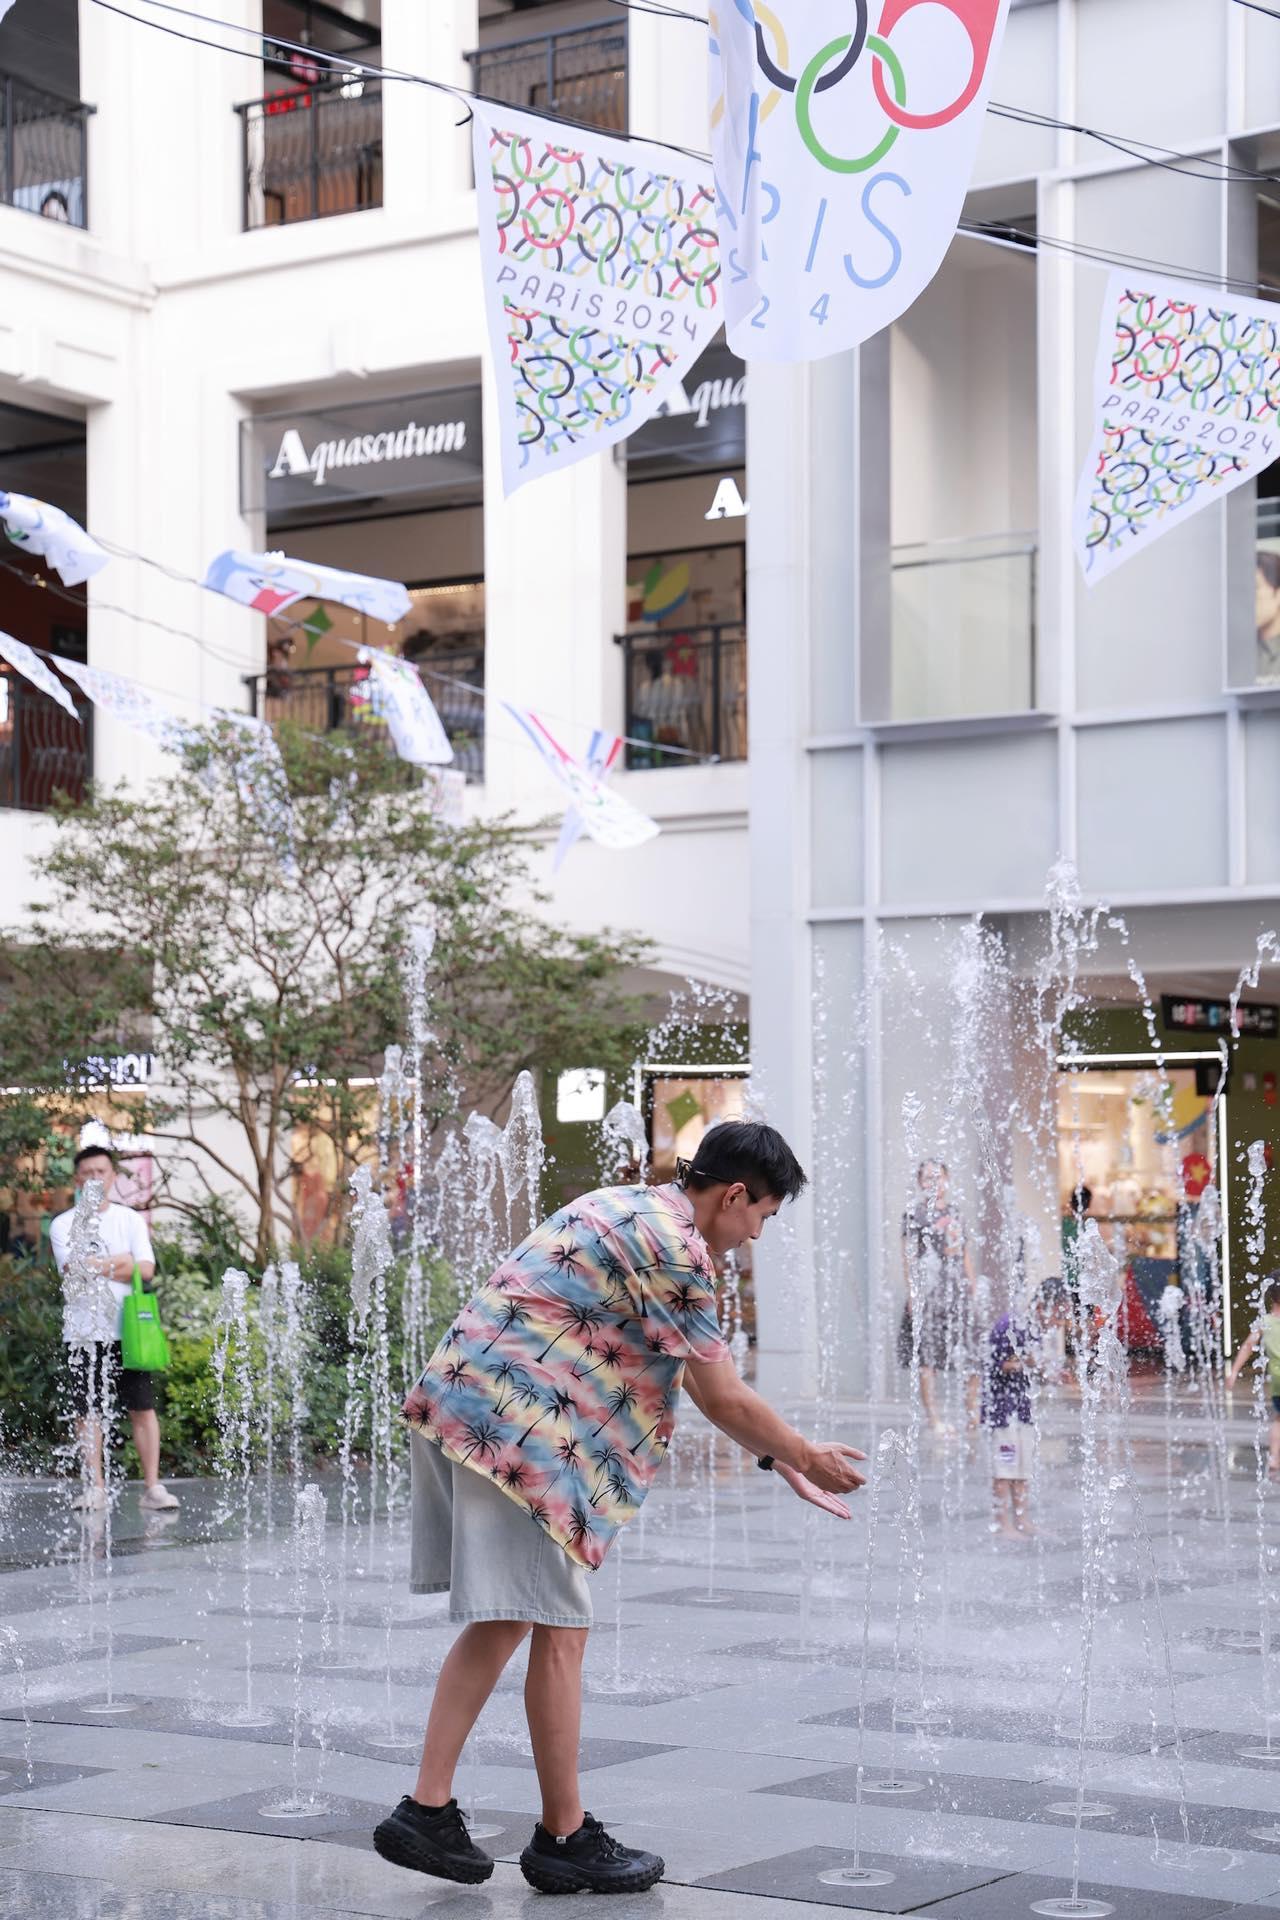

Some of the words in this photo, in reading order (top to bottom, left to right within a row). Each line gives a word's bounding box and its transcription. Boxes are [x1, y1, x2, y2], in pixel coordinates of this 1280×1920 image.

[613, 299, 697, 341] 2024
[268, 420, 466, 486] Aquascutum
[1197, 421, 1273, 454] 2024
